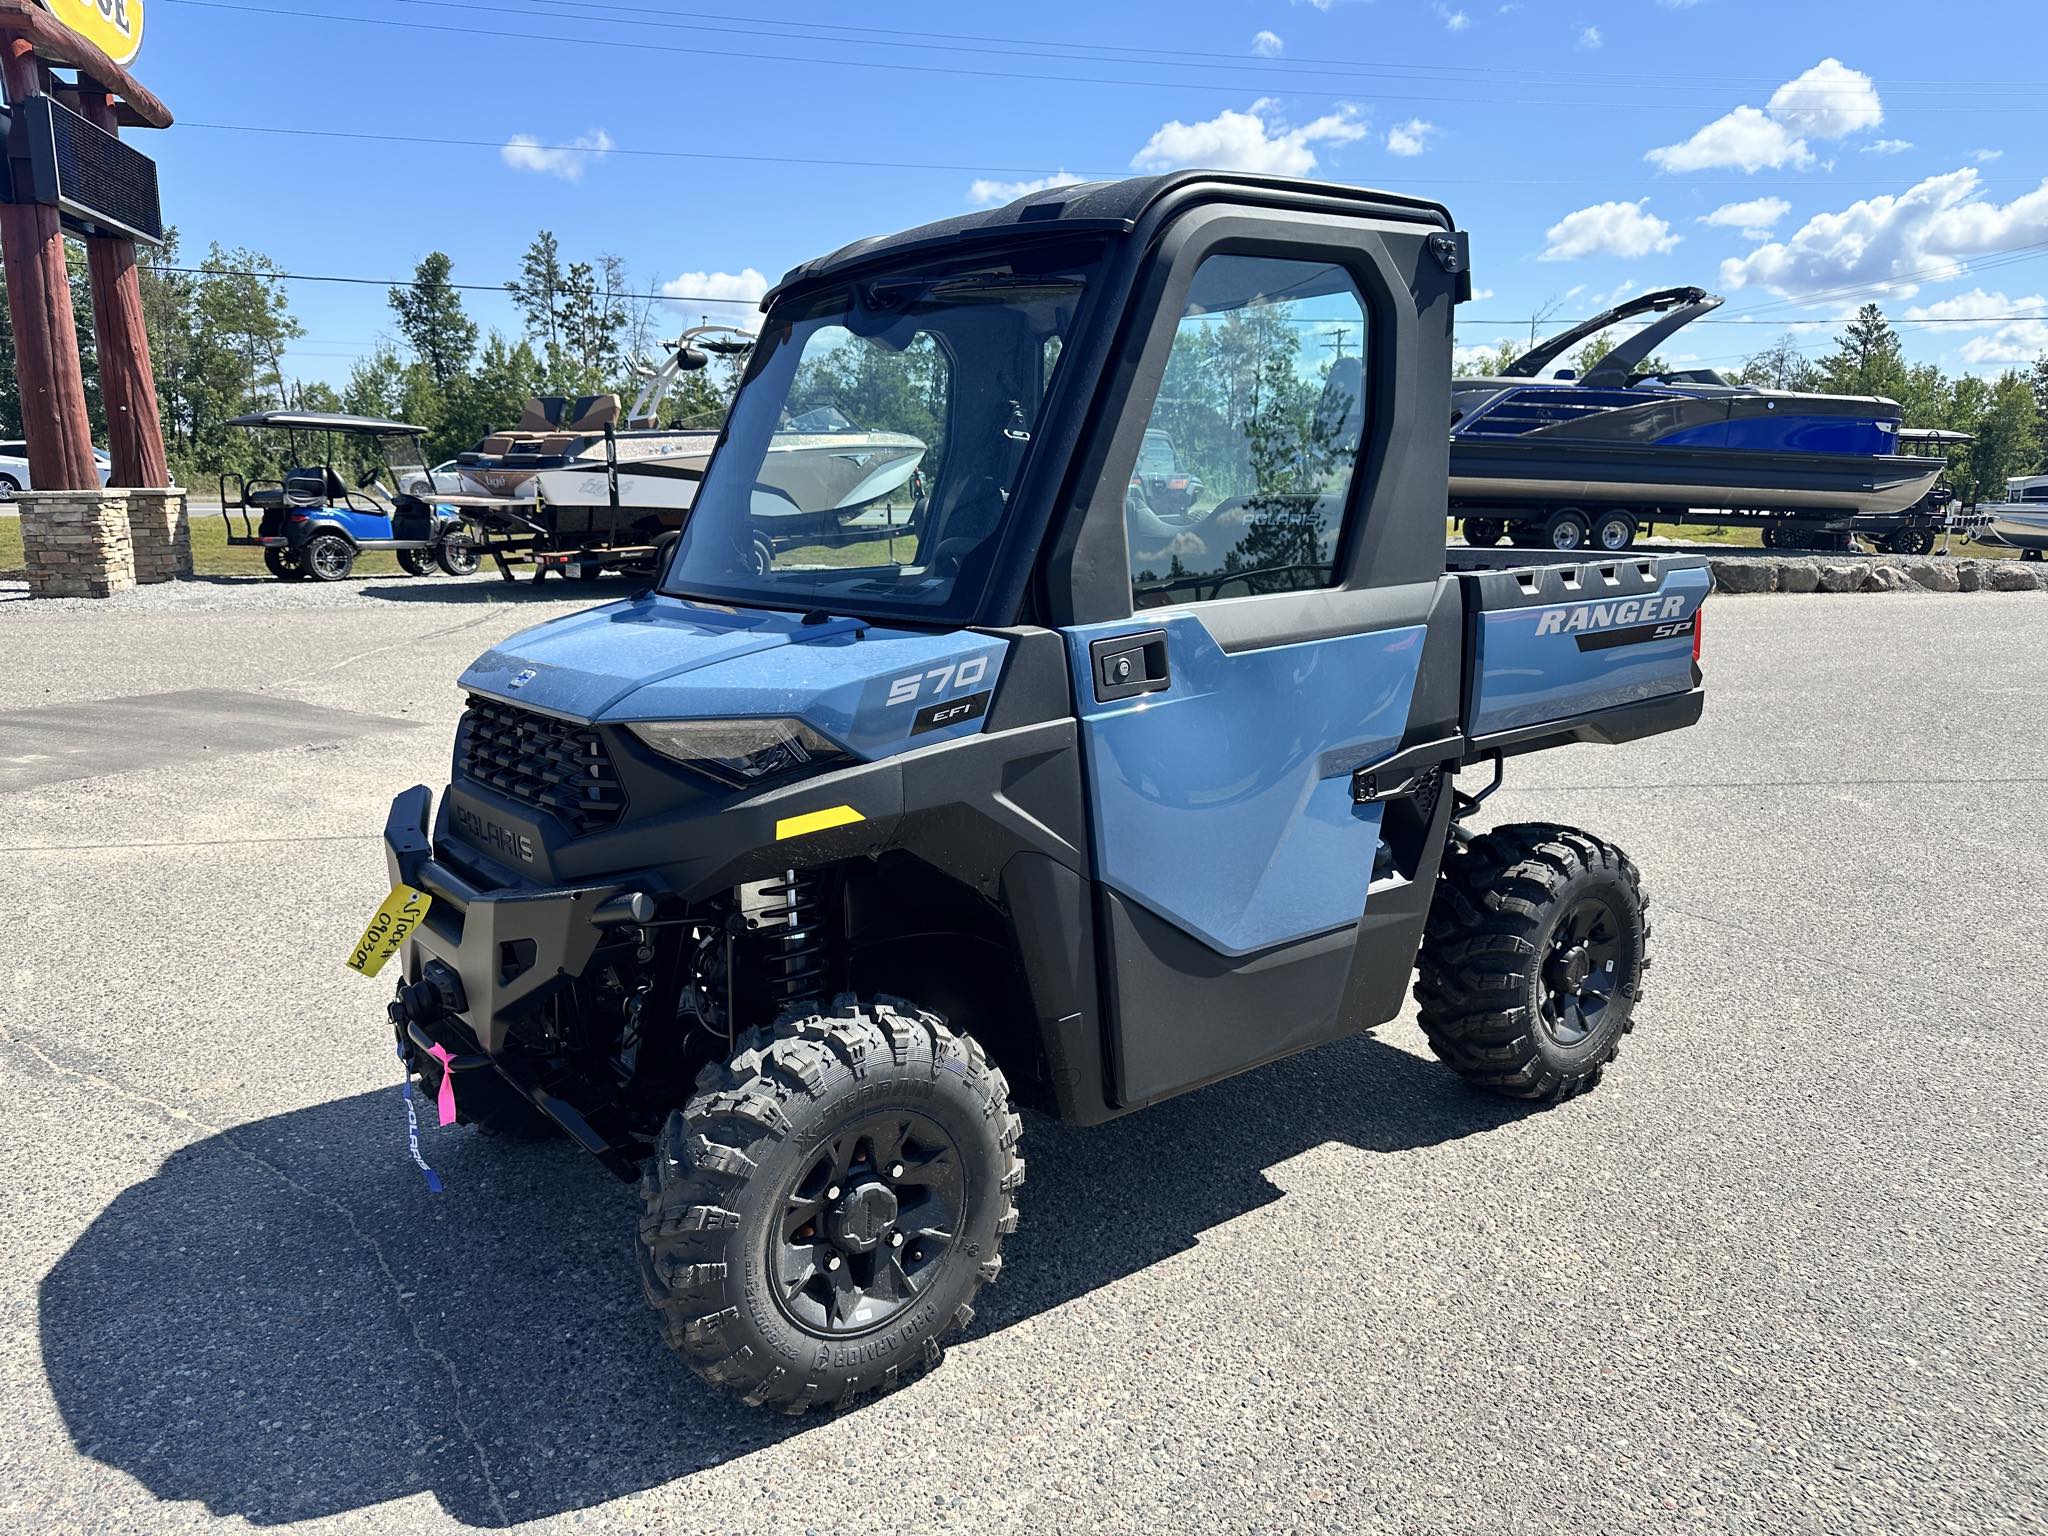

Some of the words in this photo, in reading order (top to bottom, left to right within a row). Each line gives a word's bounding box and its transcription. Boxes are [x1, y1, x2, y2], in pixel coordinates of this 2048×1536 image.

[1242, 512, 1321, 527] POLARIS
[1535, 595, 1686, 636] RANGER
[1652, 621, 1693, 639] SP
[885, 656, 988, 707] 570
[932, 703, 971, 722] EFI
[456, 805, 535, 864] POLARIS
[348, 912, 392, 970] 090309
[404, 1098, 432, 1171] POLARIS
[833, 1328, 900, 1368] ARMOR
